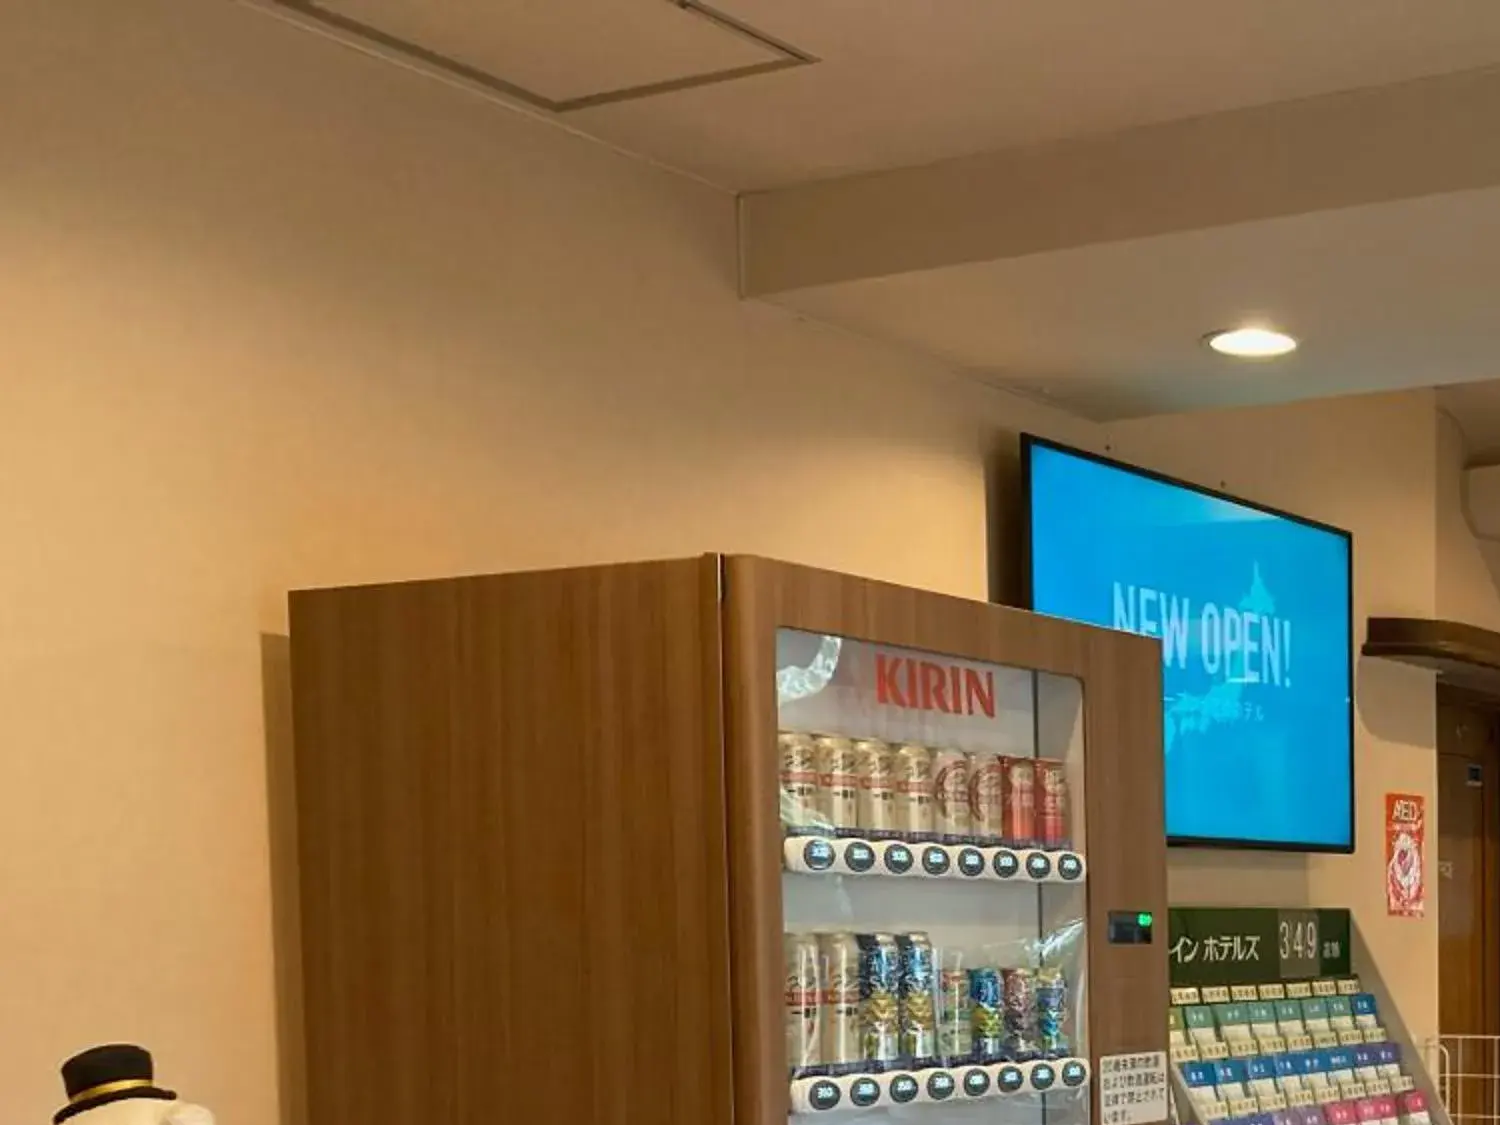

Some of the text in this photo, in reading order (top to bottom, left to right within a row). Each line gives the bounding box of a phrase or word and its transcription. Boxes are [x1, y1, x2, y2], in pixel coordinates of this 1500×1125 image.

[1201, 601, 1292, 688] OPEN!
[875, 652, 996, 718] KIRIN
[1279, 921, 1318, 960] 349
